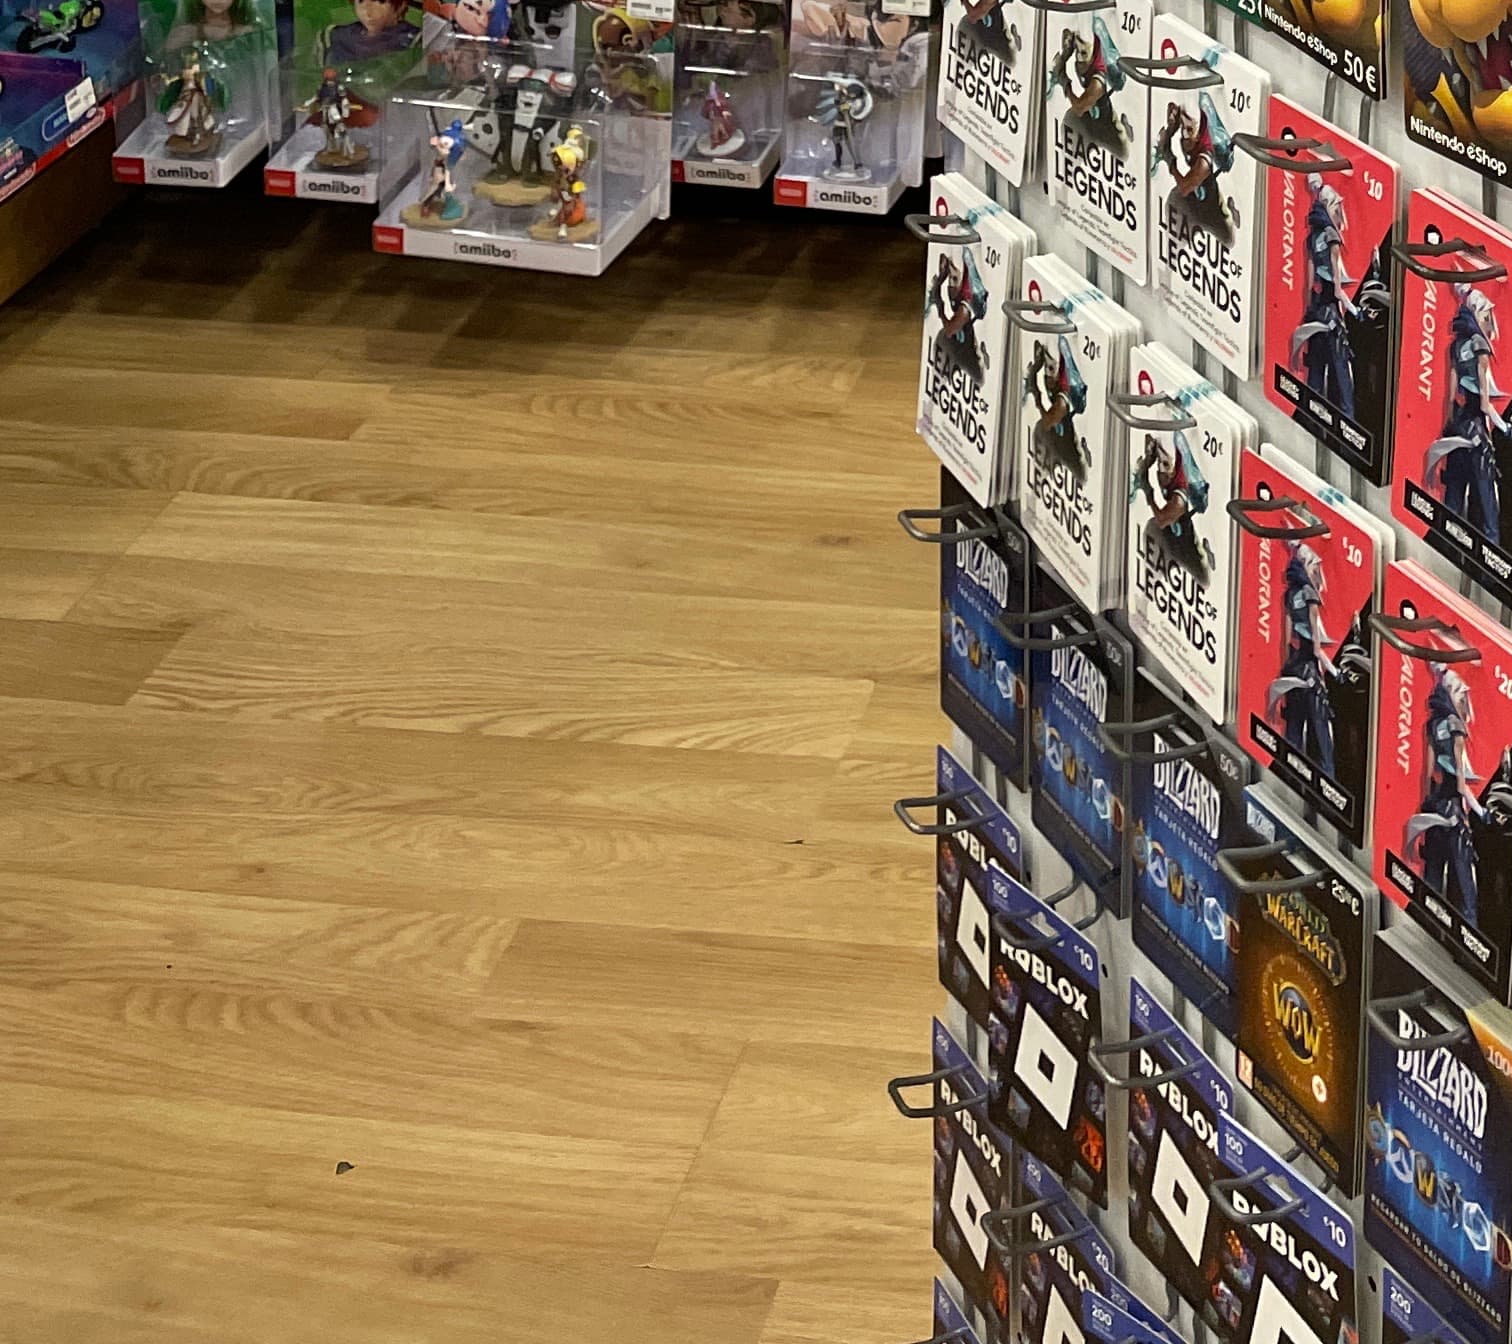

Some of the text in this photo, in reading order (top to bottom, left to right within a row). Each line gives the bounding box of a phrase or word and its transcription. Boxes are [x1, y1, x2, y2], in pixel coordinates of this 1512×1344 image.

[949, 23, 1022, 95] LEAGUE OF
[1264, 3, 1306, 44] Nintendo
[1307, 30, 1338, 65] eShop
[947, 62, 1018, 134] LEGENDS
[157, 167, 209, 181] amiibo
[1055, 116, 1124, 181] LEAGUE
[1124, 171, 1137, 191] OF
[1410, 115, 1465, 155] Nintendo
[1466, 138, 1507, 176] eShop
[1054, 160, 1137, 232] LEGENDS
[1281, 171, 1297, 291] VALORANT
[460, 242, 510, 259] amiibo
[1158, 196, 1230, 269] LEAGUE
[1230, 255, 1242, 279] OF
[1157, 239, 1242, 324] LEGENDS
[1417, 279, 1438, 403] VALORANT
[1136, 555, 1216, 665] LEGENDS
[1001, 938, 1088, 1019] ROBLOX
